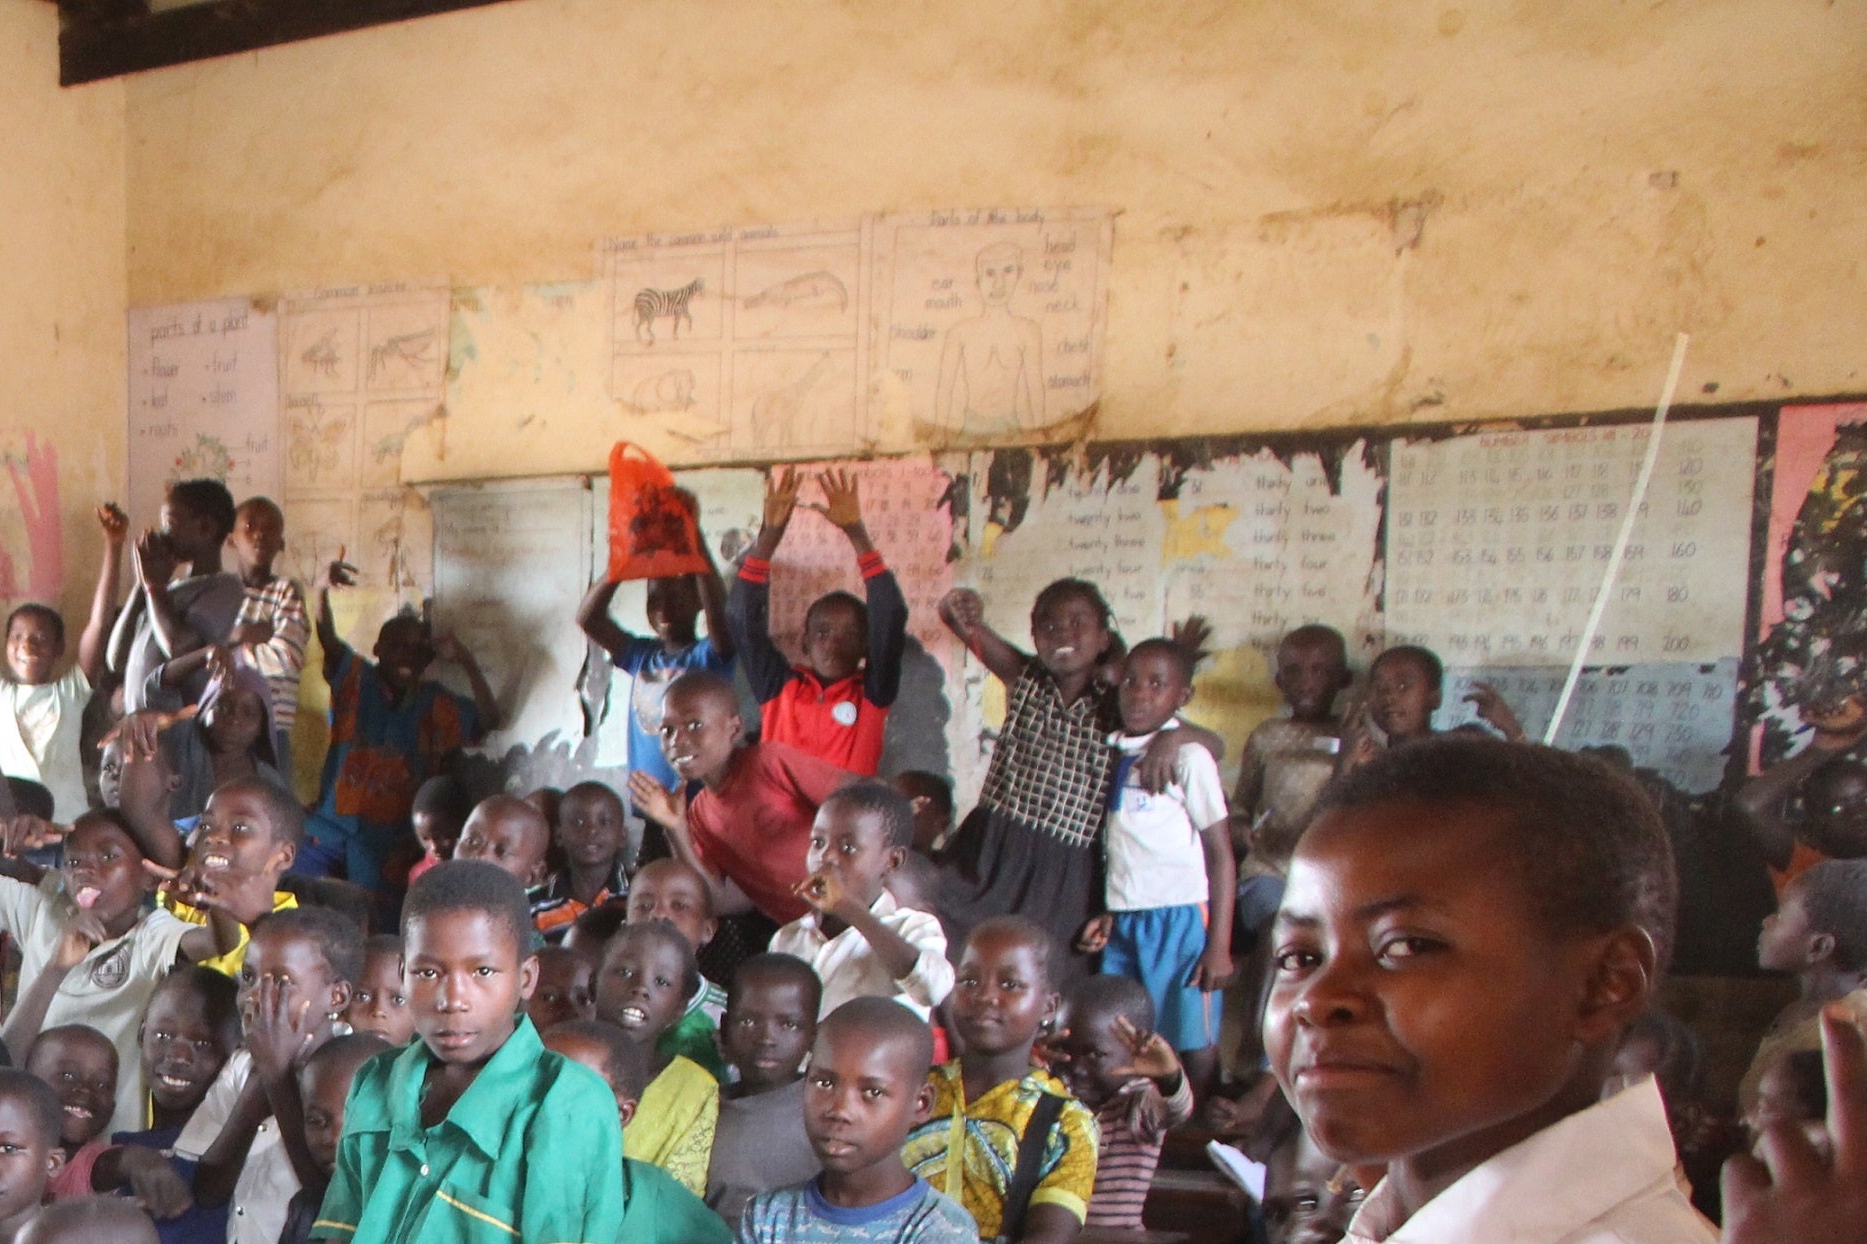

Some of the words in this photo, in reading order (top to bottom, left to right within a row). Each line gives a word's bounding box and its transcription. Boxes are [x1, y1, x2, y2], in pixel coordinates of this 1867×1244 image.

[1044, 231, 1076, 254] head
[1043, 259, 1072, 284] eye
[1303, 501, 1331, 515] two
